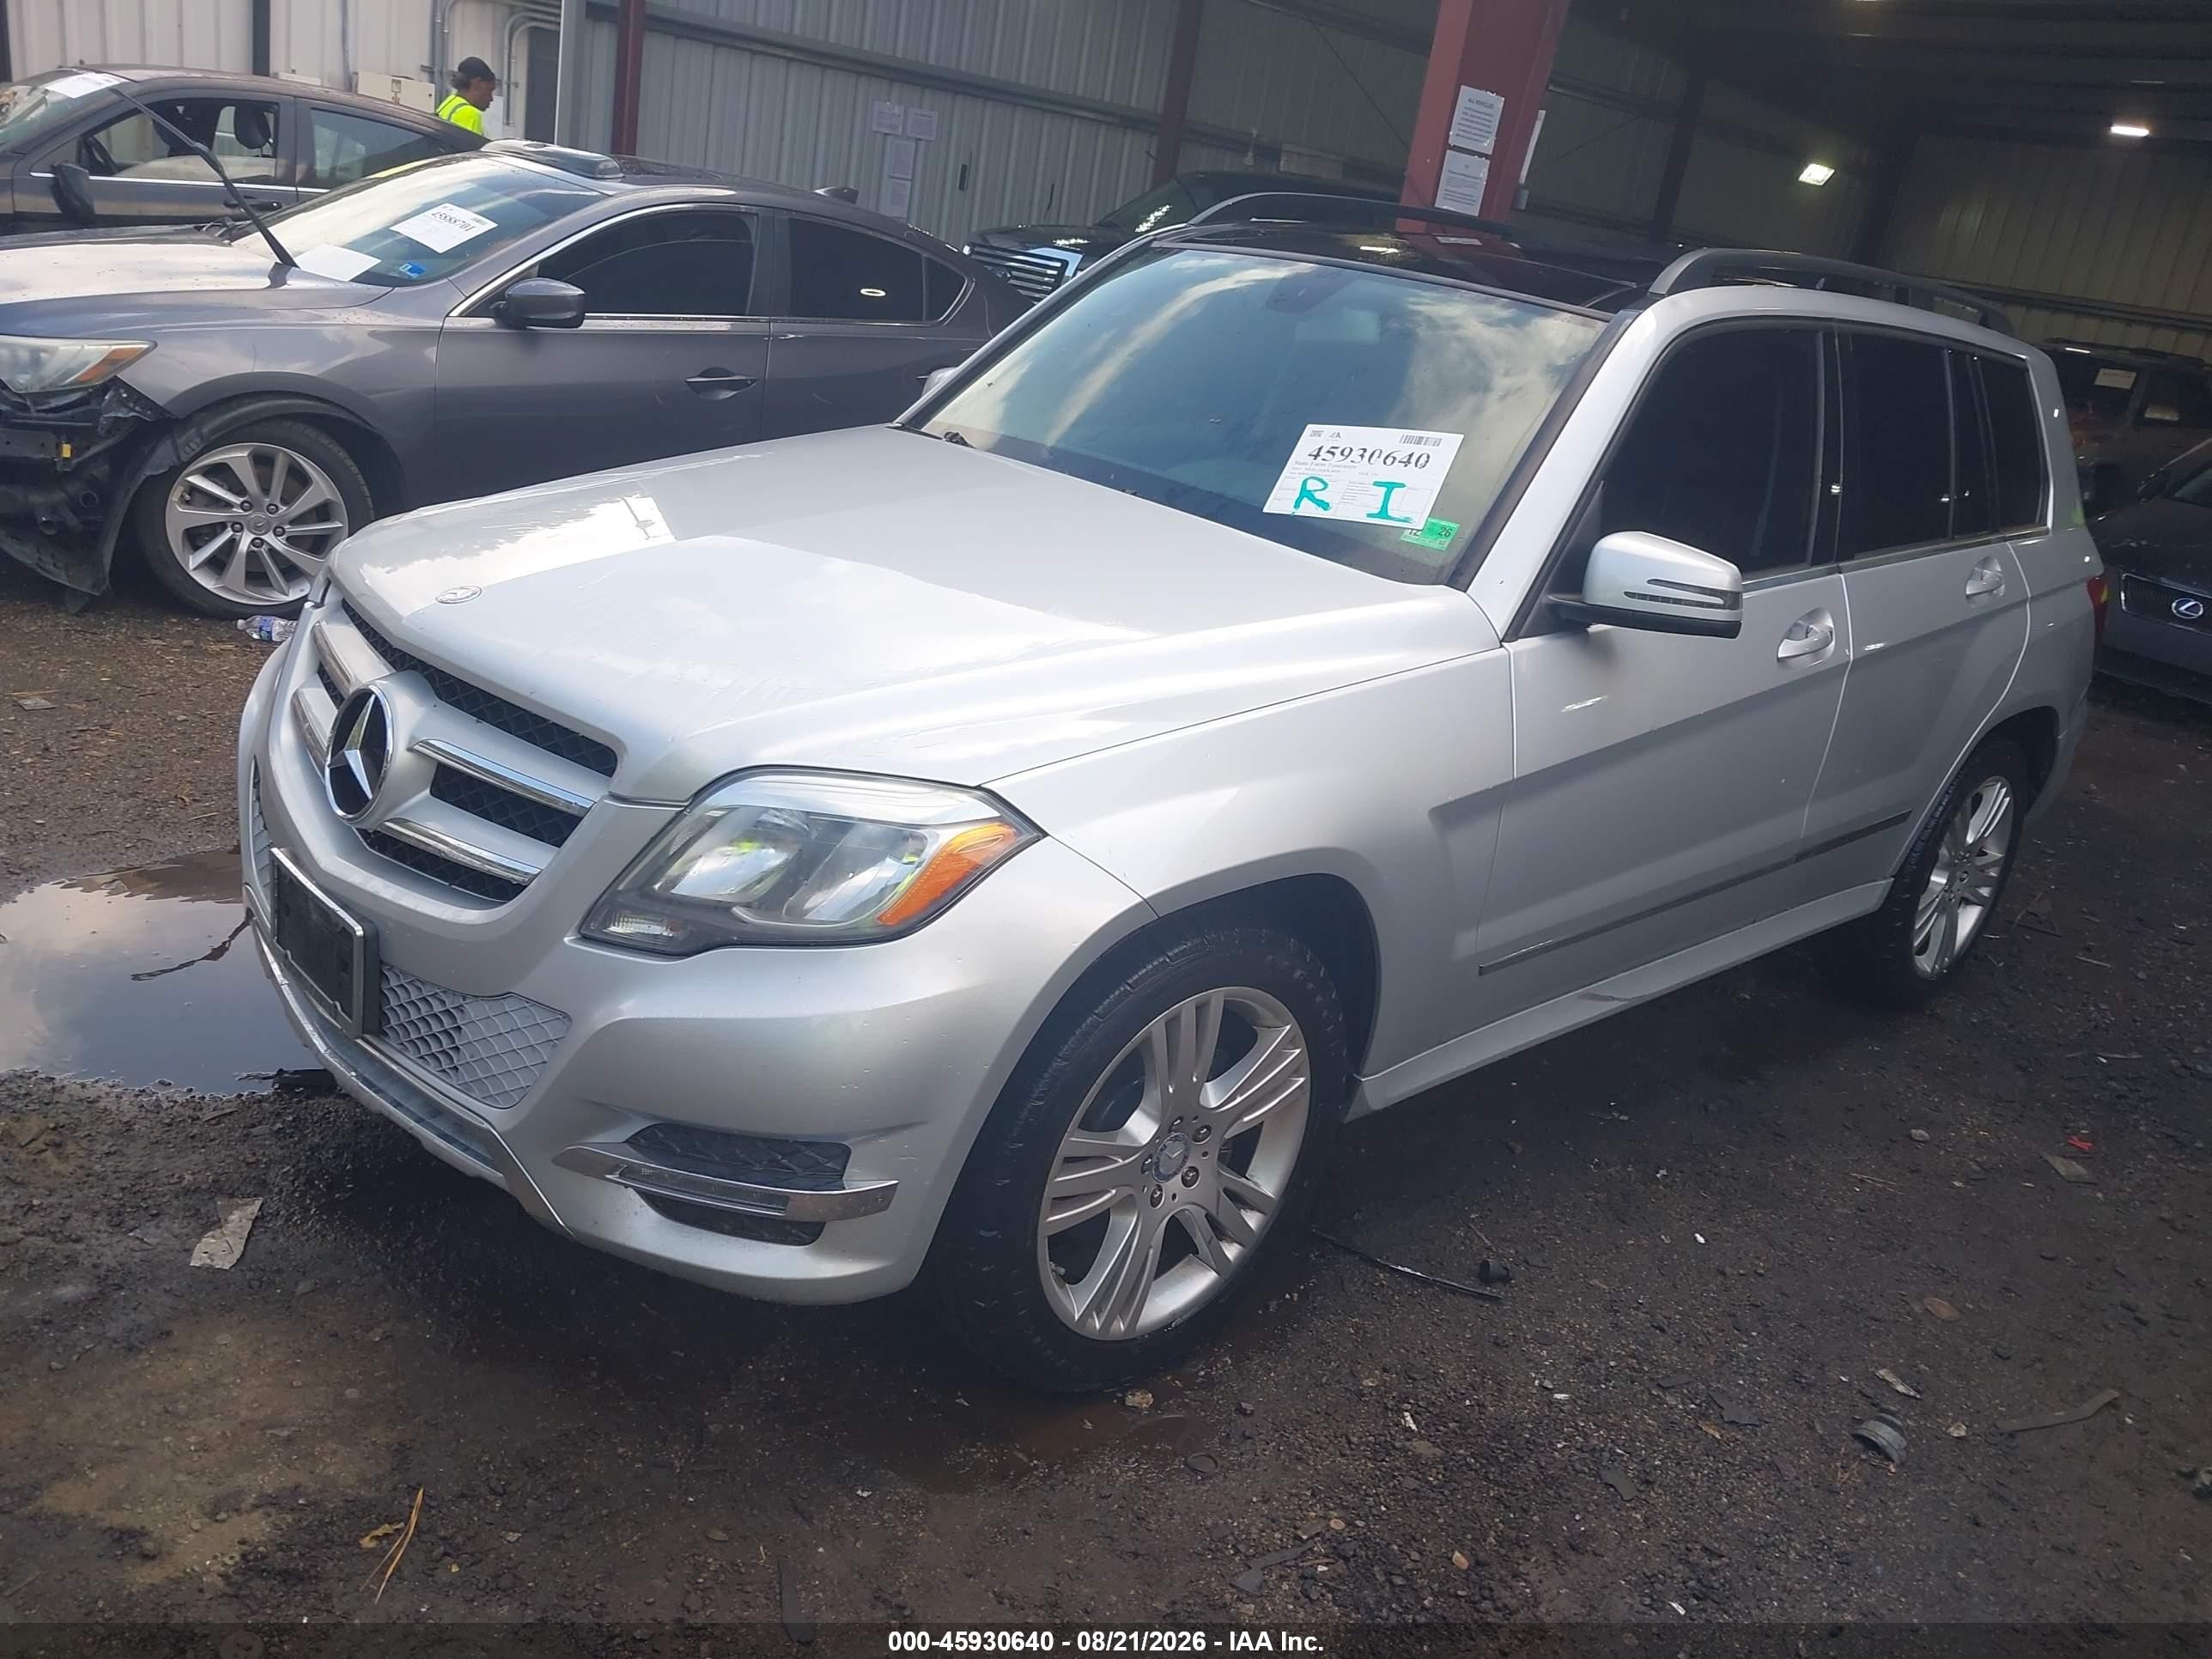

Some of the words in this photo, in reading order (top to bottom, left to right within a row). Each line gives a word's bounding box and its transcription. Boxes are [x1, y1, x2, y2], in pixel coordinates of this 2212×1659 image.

[1308, 445, 1431, 470] 45930640
[1294, 476, 1332, 512] R
[1365, 480, 1415, 523] I
[1438, 526, 1453, 538] 26
